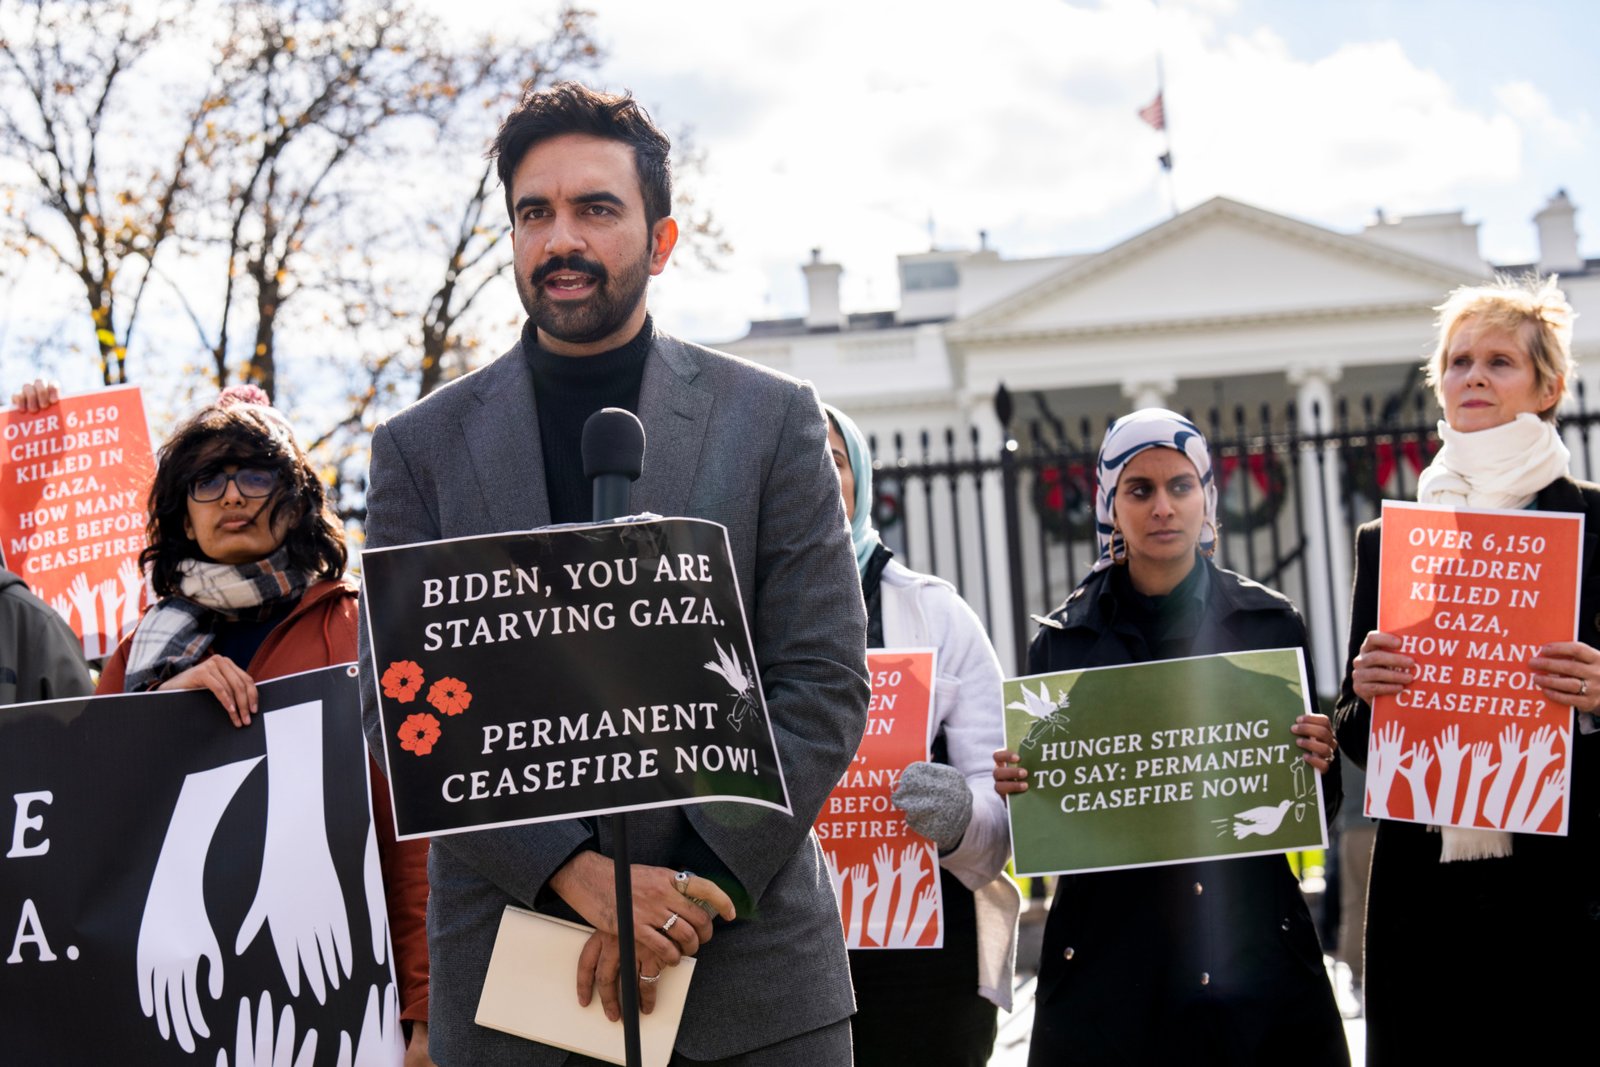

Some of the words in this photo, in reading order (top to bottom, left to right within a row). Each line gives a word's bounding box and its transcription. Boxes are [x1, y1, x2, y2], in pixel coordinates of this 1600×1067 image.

[4, 415, 59, 441] OVER
[66, 406, 119, 429] 6,150
[11, 427, 120, 461] CHILDREN
[16, 453, 92, 484] KILLED
[99, 448, 124, 467] IN
[42, 475, 106, 501] GAZA,
[19, 504, 68, 530] HOW
[75, 490, 138, 517] MANY
[11, 527, 69, 555] MORE
[1408, 527, 1473, 550] OVER
[1482, 533, 1546, 555] 6,150
[422, 566, 552, 608] BIDEN,
[563, 557, 638, 590] YOU
[654, 554, 713, 583] ARE
[1410, 554, 1542, 581] CHILDREN
[1409, 582, 1500, 606] KILLED
[1508, 590, 1540, 608] IN
[423, 603, 616, 651] STARVING
[629, 597, 725, 628] GAZA.
[1434, 611, 1509, 637] GAZA,
[1400, 634, 1459, 656] HOW
[1466, 640, 1542, 662] MANY
[1408, 663, 1453, 684] ORE
[1461, 667, 1543, 691] BEFOR
[1395, 688, 1546, 718] CEASEFIRE?
[481, 702, 718, 755] PERMANENT
[865, 718, 895, 736] IN
[1040, 733, 1143, 762] HUNGER
[1150, 719, 1270, 750] STRIKING
[441, 748, 659, 803] CEASEFIRE
[674, 744, 760, 777] NOW!
[1034, 767, 1067, 790] TO
[1074, 761, 1126, 786] SAY:
[1135, 744, 1290, 779] PERMANENT
[829, 794, 903, 814] BEFO
[1060, 781, 1193, 814] CEASEFIRE
[1201, 773, 1269, 799] NOW!
[818, 820, 909, 840] SEFIRE?
